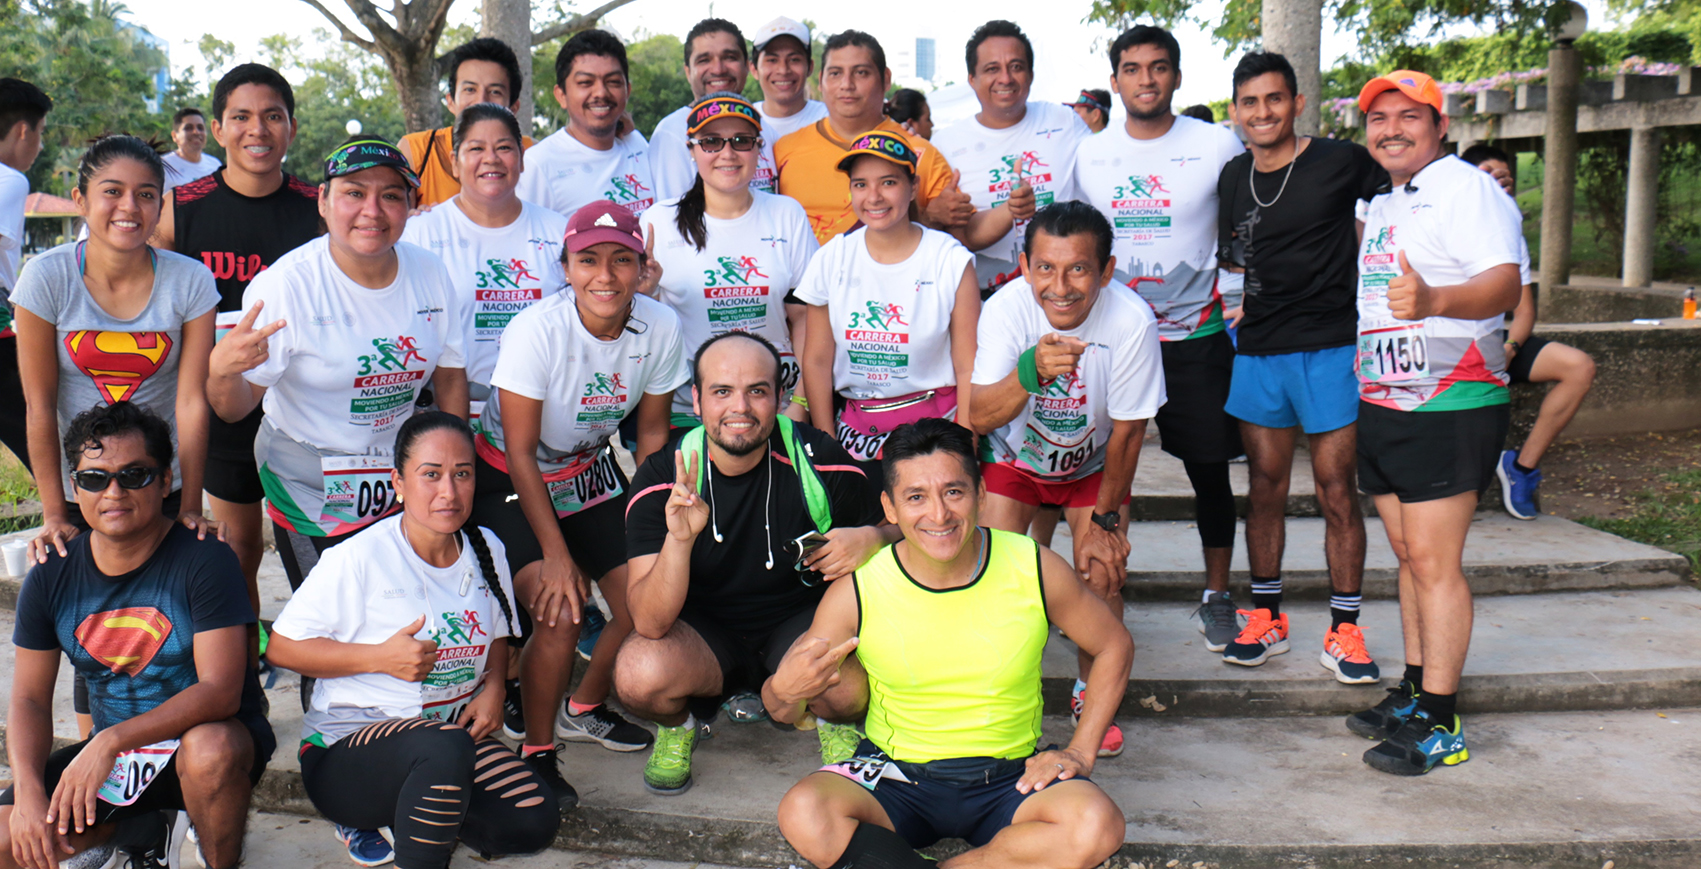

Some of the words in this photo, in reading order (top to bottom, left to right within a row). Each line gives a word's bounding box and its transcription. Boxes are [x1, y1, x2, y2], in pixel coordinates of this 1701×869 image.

[361, 146, 399, 160] México
[1116, 199, 1164, 208] CARRERA
[1118, 208, 1163, 216] NACIONAL
[201, 251, 268, 282] Wil
[482, 290, 534, 300] CARRERA
[710, 287, 761, 298] CARRERA
[712, 298, 761, 307] NACIONAL
[850, 331, 901, 343] CARRERA
[851, 342, 900, 352] NACIONAL
[1375, 335, 1426, 375] 1150
[361, 372, 417, 387] CARRERA
[360, 382, 413, 397] NACIONAL
[354, 397, 389, 406] MOVIENDO
[388, 398, 405, 408] SALUD
[585, 396, 621, 404] CARRERA
[1044, 398, 1081, 409] RRERA
[350, 411, 388, 420] SECRETARÍA
[374, 415, 394, 427] 2017
[371, 423, 396, 434] TABASCO
[1048, 437, 1093, 472] 1091
[575, 455, 616, 503] 0280
[433, 658, 476, 671] NACIONAL
